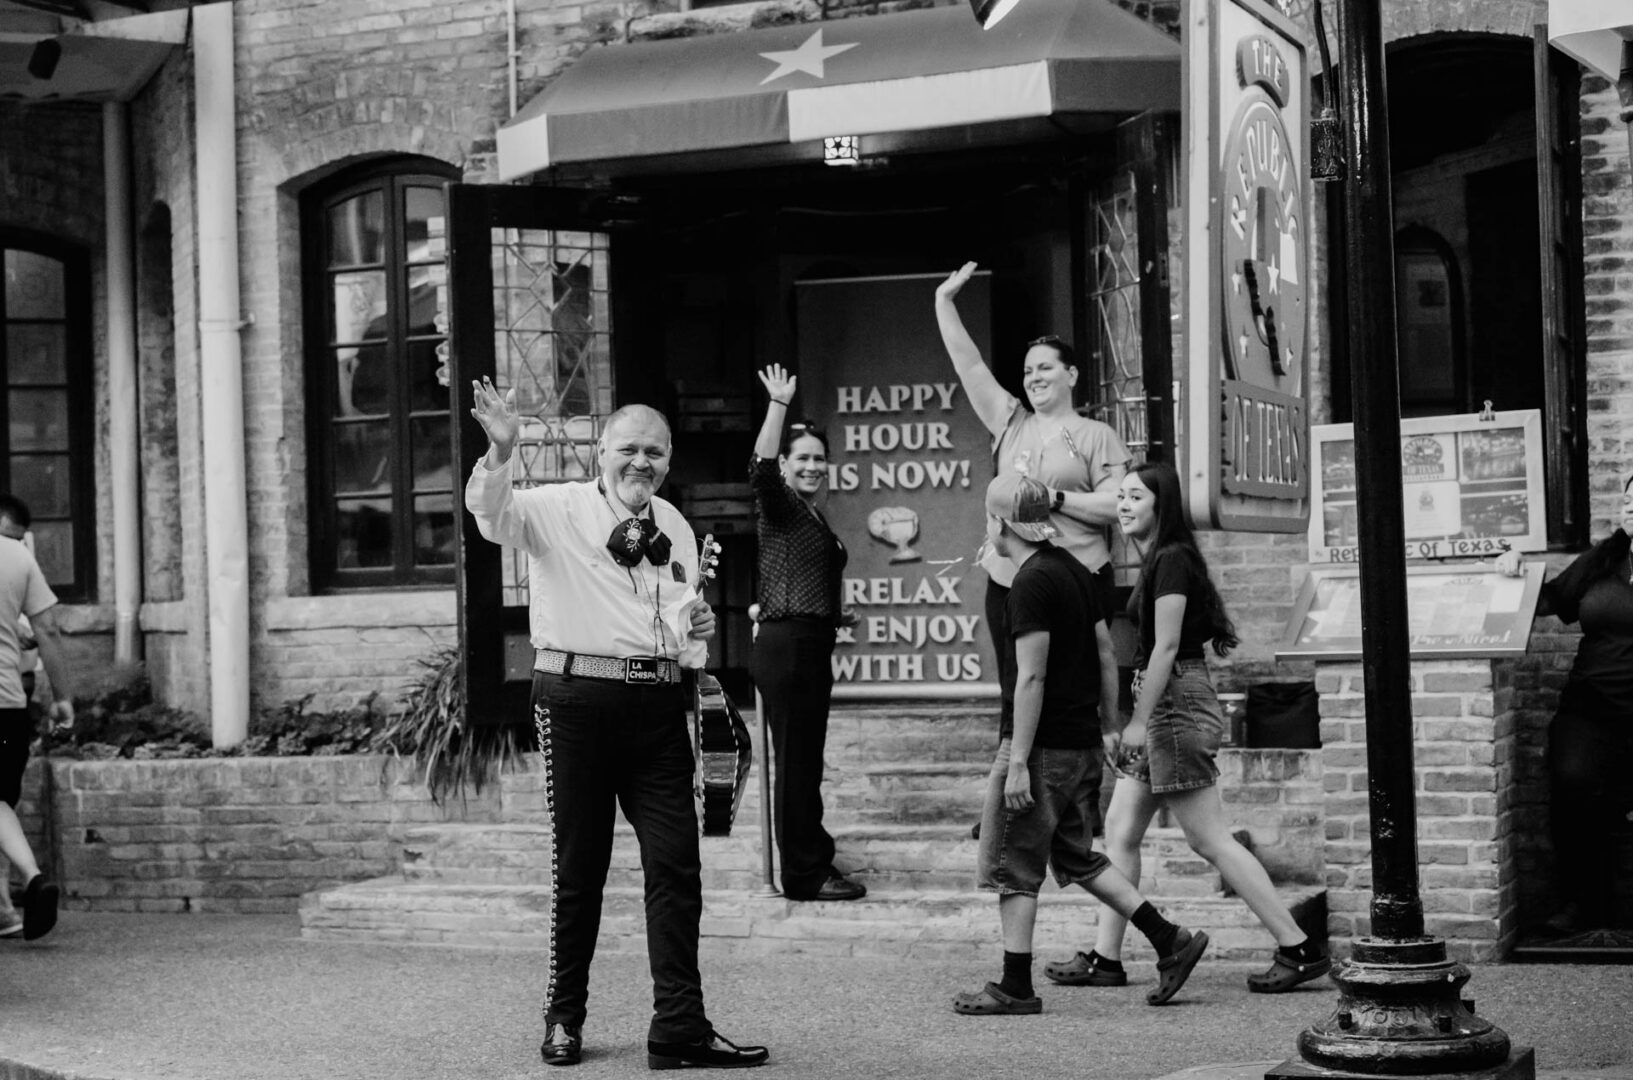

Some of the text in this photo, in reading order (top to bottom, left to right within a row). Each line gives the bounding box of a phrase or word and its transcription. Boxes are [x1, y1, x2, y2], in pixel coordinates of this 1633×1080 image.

[1251, 39, 1284, 90] THE
[1230, 119, 1299, 241] REPUBLIC
[836, 382, 958, 413] HAPPY
[844, 422, 954, 452] HOUR
[1231, 395, 1300, 488] OF TEXAS
[827, 459, 970, 491] IS NOW!
[1448, 538, 1507, 558] Texas
[843, 576, 962, 605] RELAX
[867, 614, 980, 649] ENJOY
[629, 670, 657, 680] CHISPA
[632, 662, 642, 670] LA
[830, 653, 982, 682] WITH US
